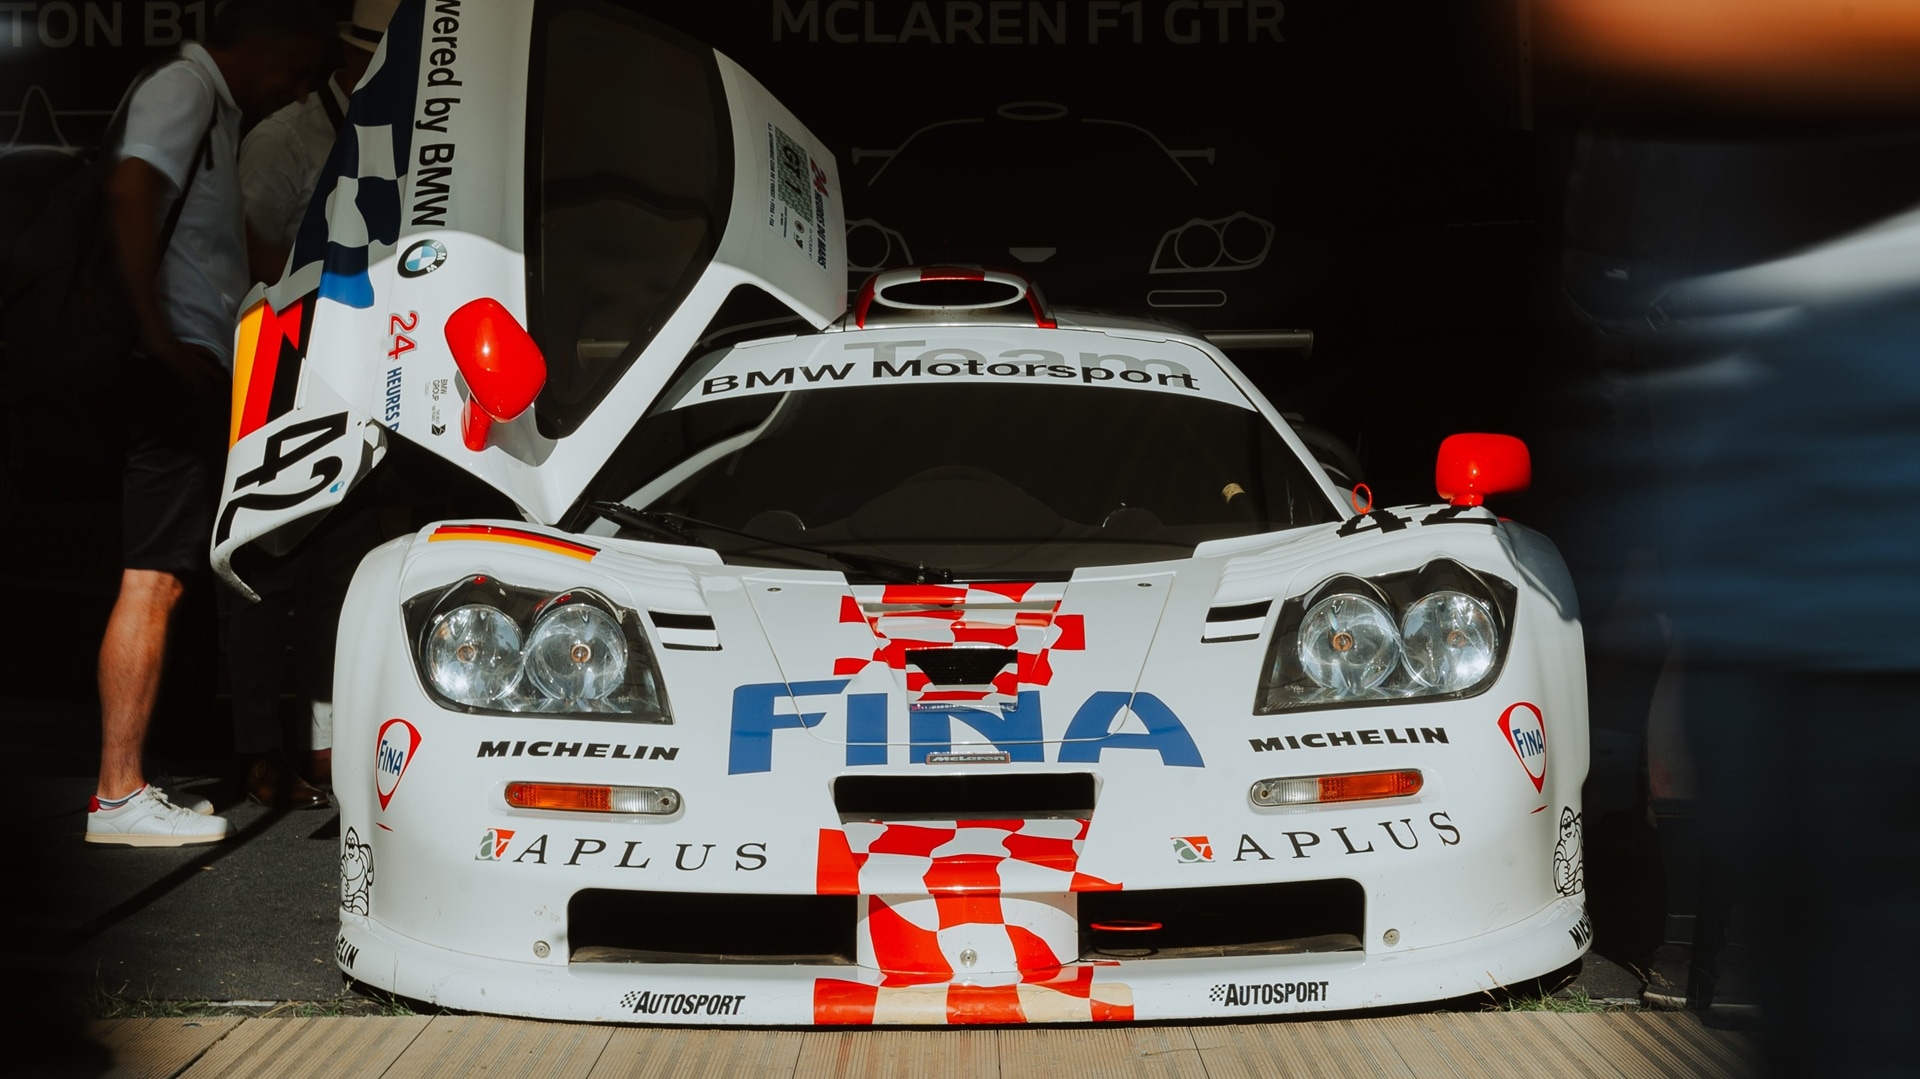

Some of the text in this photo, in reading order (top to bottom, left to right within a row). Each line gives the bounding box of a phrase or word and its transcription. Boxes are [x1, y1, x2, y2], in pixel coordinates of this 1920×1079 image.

[144, 1, 222, 47] B1
[772, 0, 1287, 45] MCLAREN F1 GTR
[415, 98, 461, 133] by
[782, 145, 801, 180] GT
[811, 157, 829, 198] 24
[411, 143, 456, 226] BMW
[388, 311, 419, 360] 24
[702, 359, 1200, 396] BMW Motorsport
[844, 339, 1192, 388] Team
[385, 366, 402, 422] HEURES
[214, 411, 349, 550] 42
[728, 679, 1205, 775] FINA
[1248, 727, 1450, 752] MICHELIN
[1512, 728, 1545, 758] FINA
[378, 739, 404, 776] FINA
[477, 741, 680, 761] MICHELIN
[512, 834, 768, 871] APLUS
[1232, 811, 1461, 862] APLUS
[632, 991, 746, 1015] AUTOSPORT
[1224, 981, 1329, 1007] AUTOSPORT
